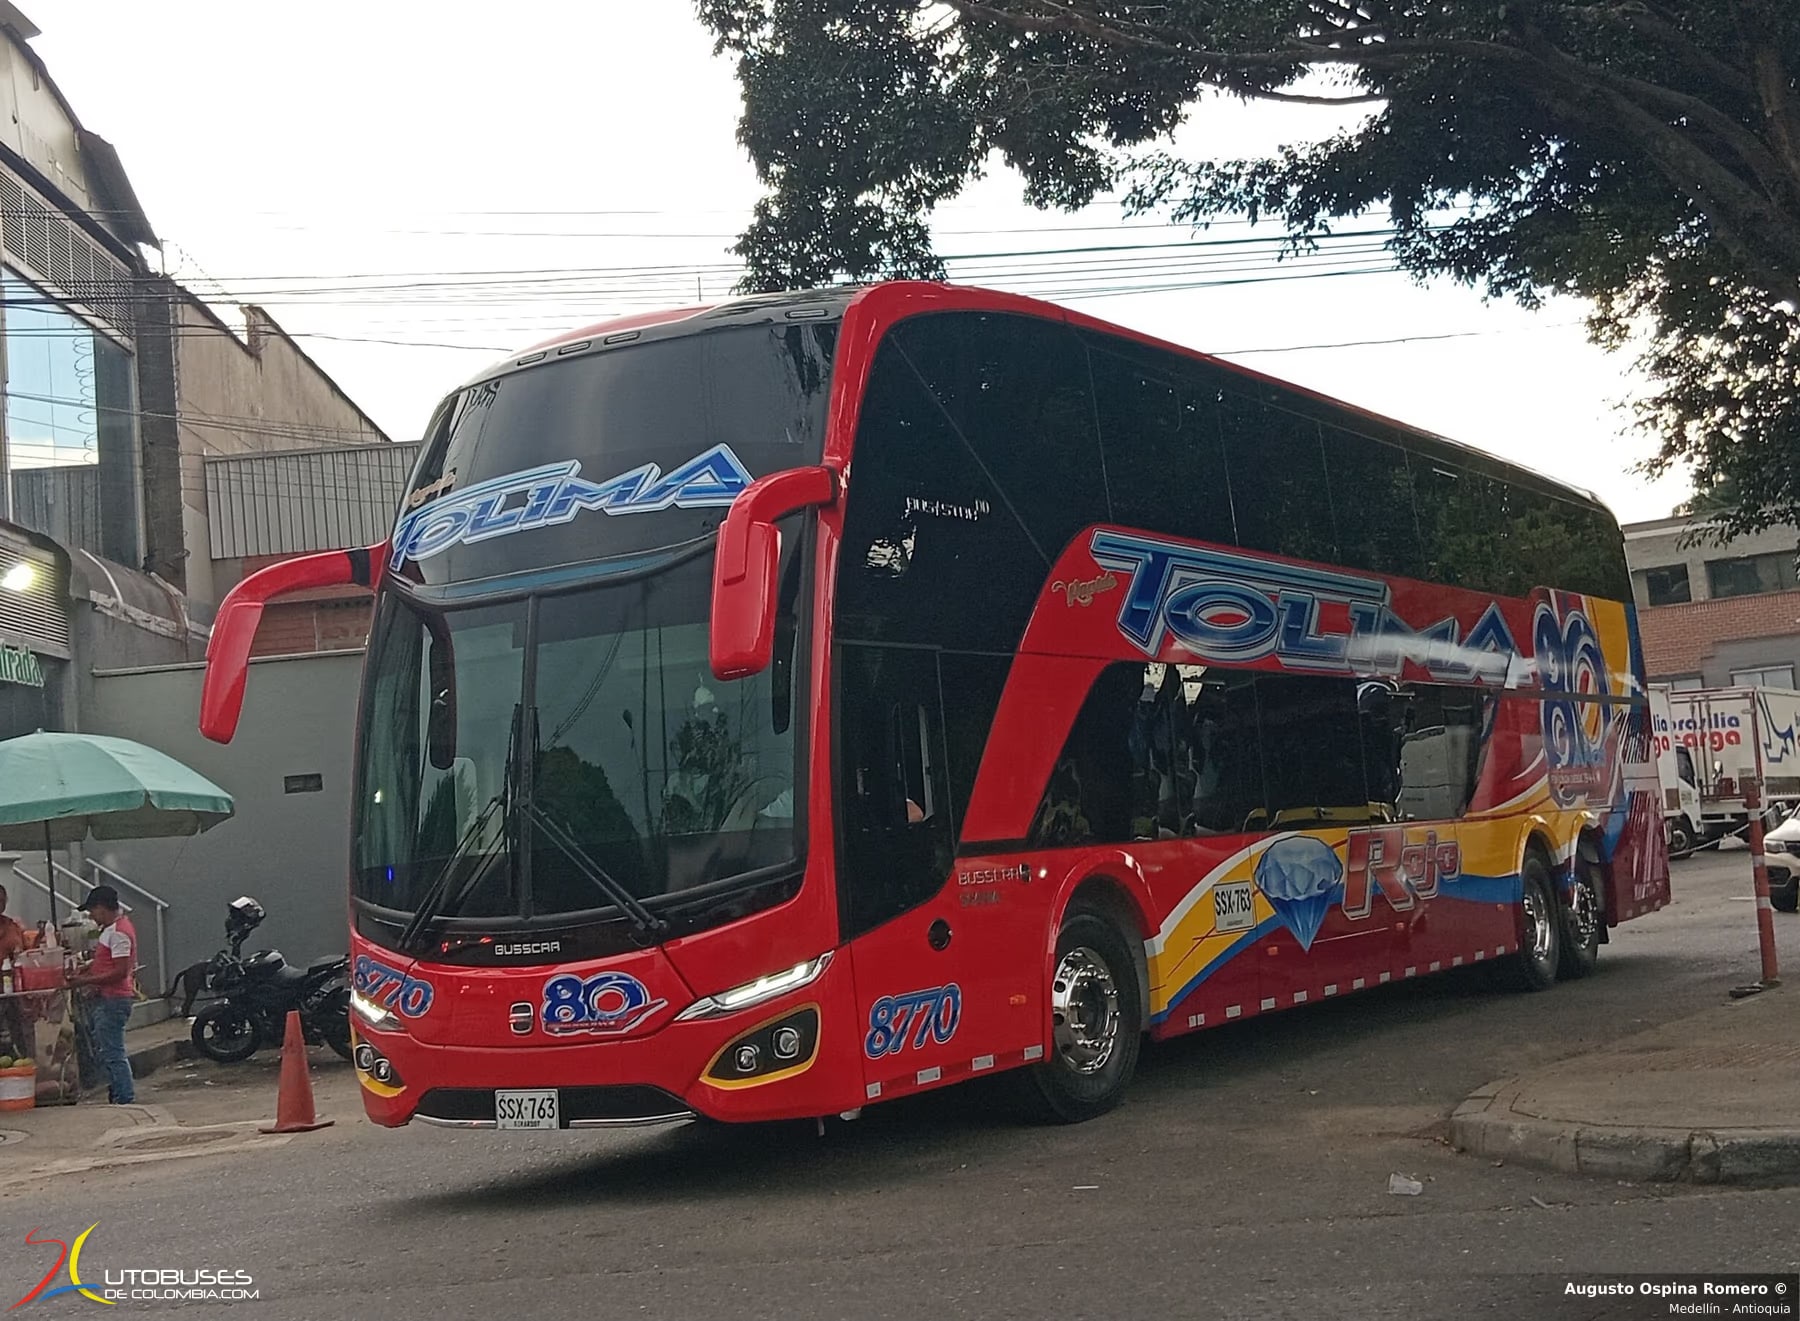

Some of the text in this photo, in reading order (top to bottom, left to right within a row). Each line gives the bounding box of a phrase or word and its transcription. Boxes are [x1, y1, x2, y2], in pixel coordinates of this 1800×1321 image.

[390, 443, 755, 571] TOLIMA
[1090, 528, 1535, 687] TOLIMA
[1674, 731, 1741, 752] arga
[495, 941, 560, 956] BUSSCAR
[353, 954, 434, 1019] 8770
[540, 971, 652, 1024] 80
[864, 982, 962, 1060] 8770
